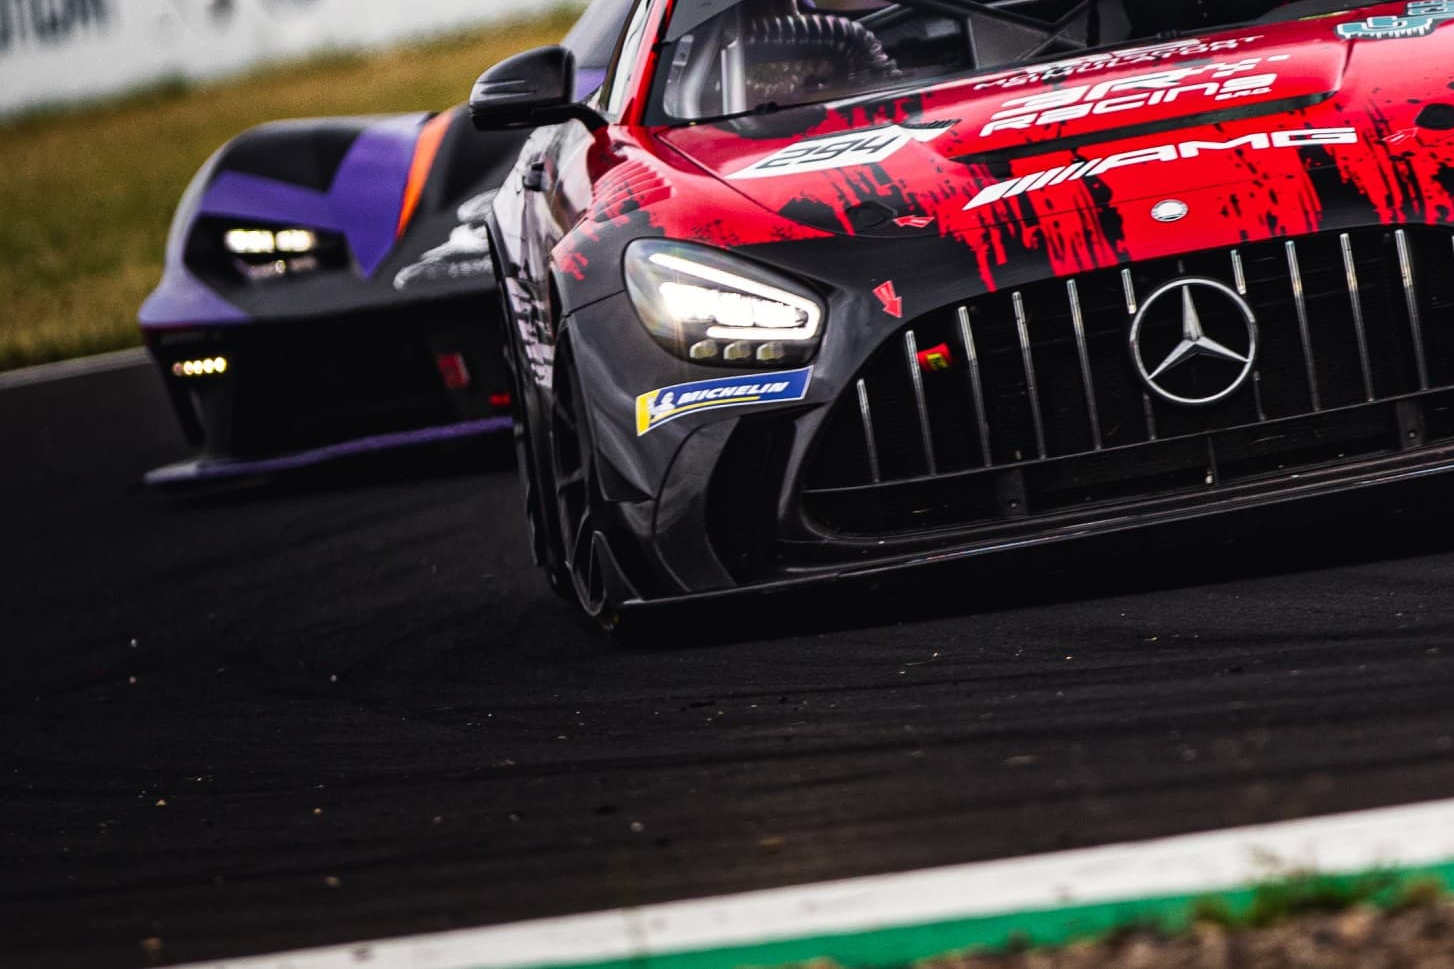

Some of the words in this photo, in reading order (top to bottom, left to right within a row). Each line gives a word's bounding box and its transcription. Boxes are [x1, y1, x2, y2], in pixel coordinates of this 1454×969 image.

[755, 135, 901, 170] 294
[1089, 127, 1357, 173] AMG
[677, 381, 790, 406] MICHELIN
